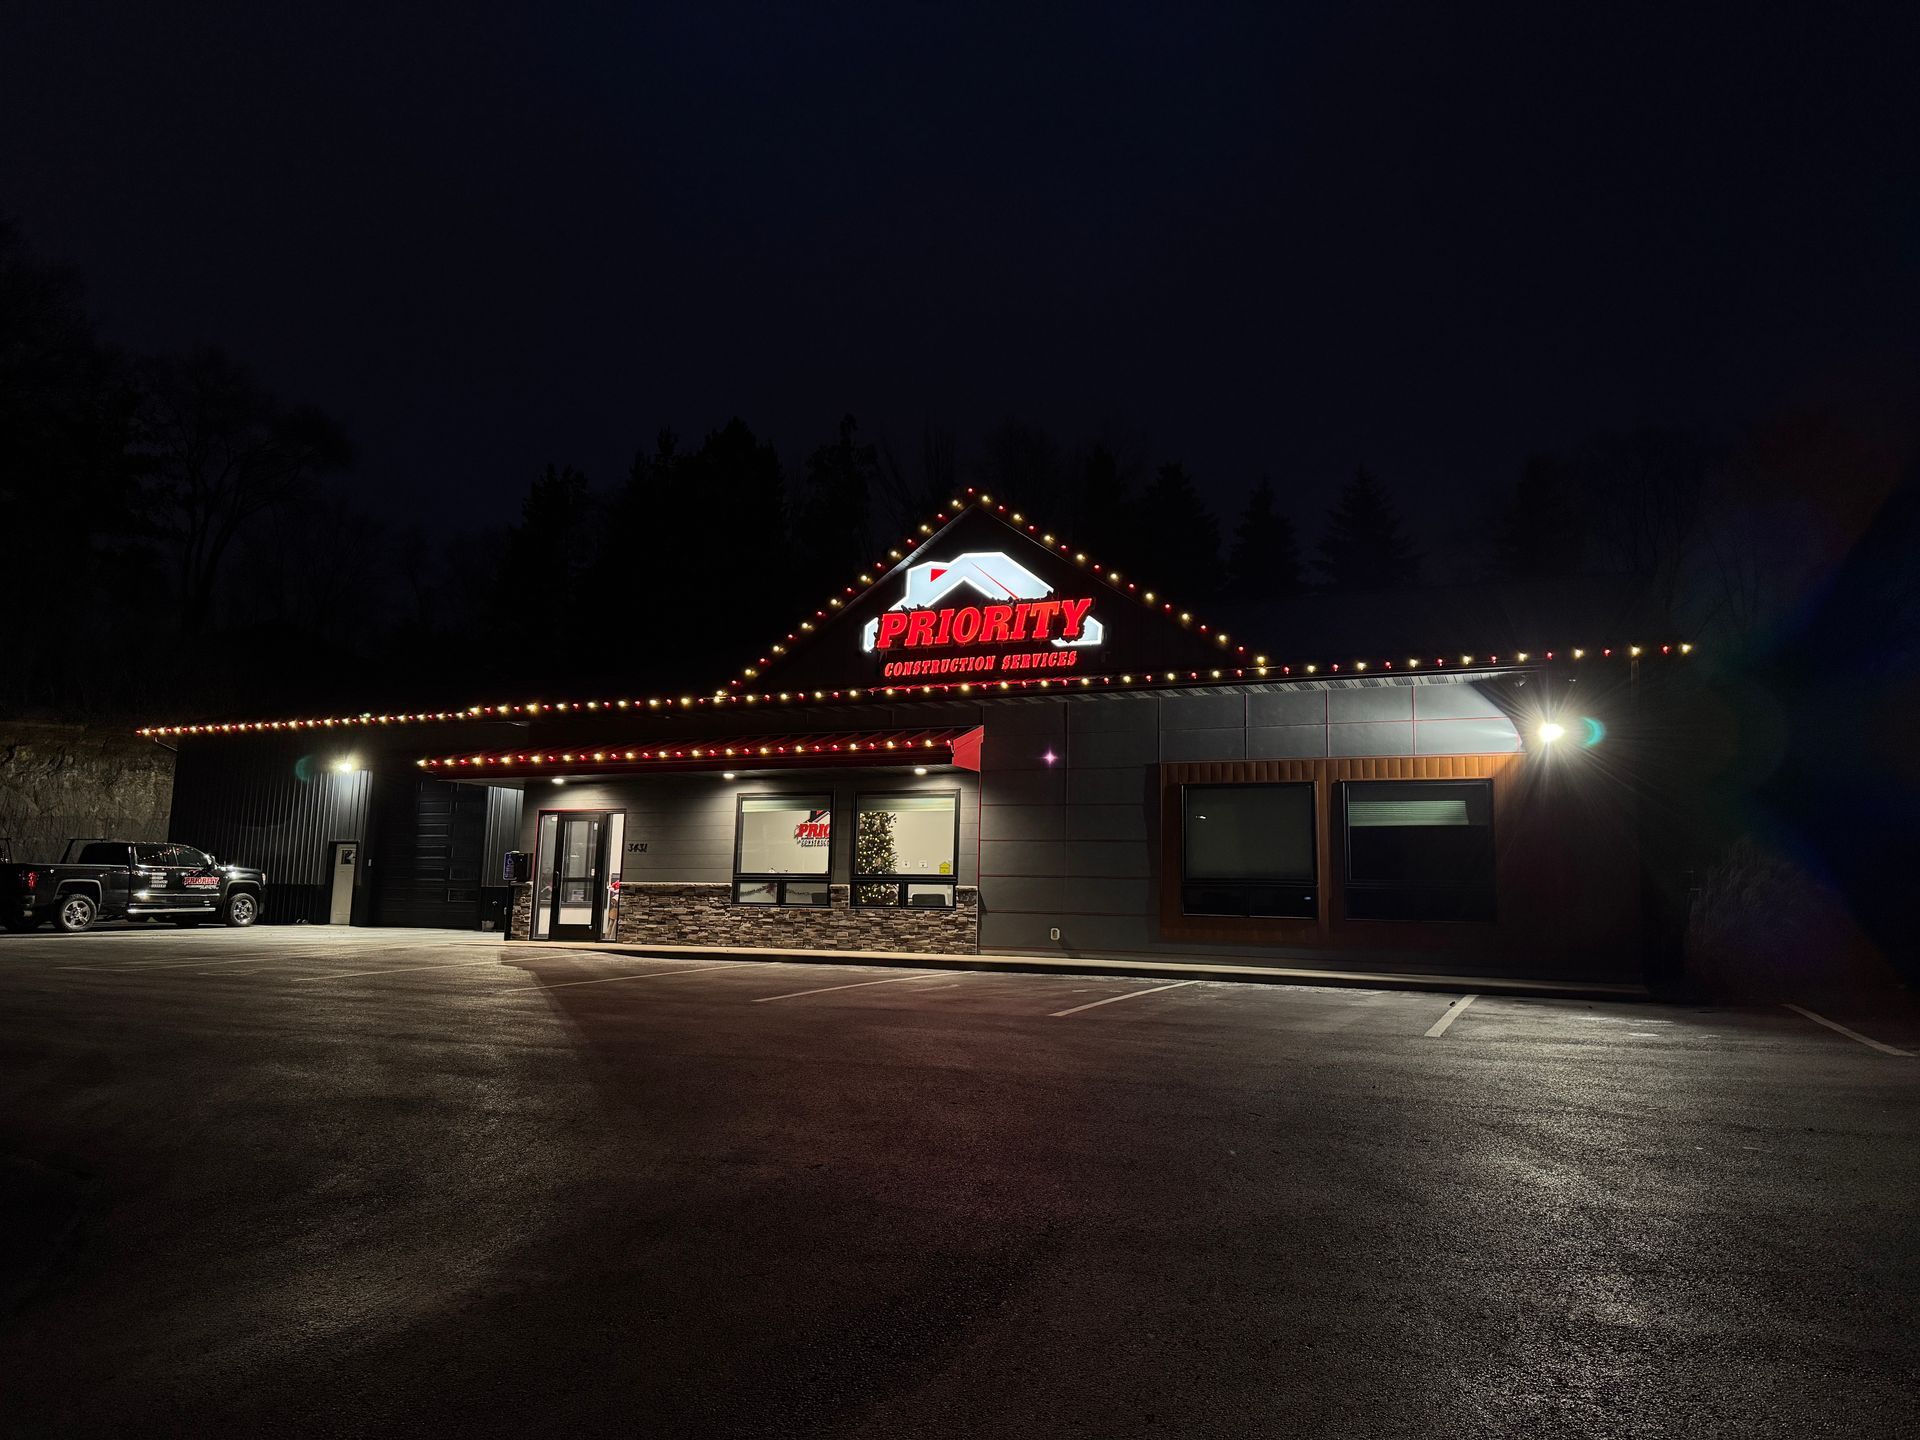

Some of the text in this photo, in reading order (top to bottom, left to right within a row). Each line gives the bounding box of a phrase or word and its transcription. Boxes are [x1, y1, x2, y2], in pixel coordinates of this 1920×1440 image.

[876, 598, 1093, 649] PRIORITY
[884, 650, 1078, 677] CONSTRUCTION SERVICES
